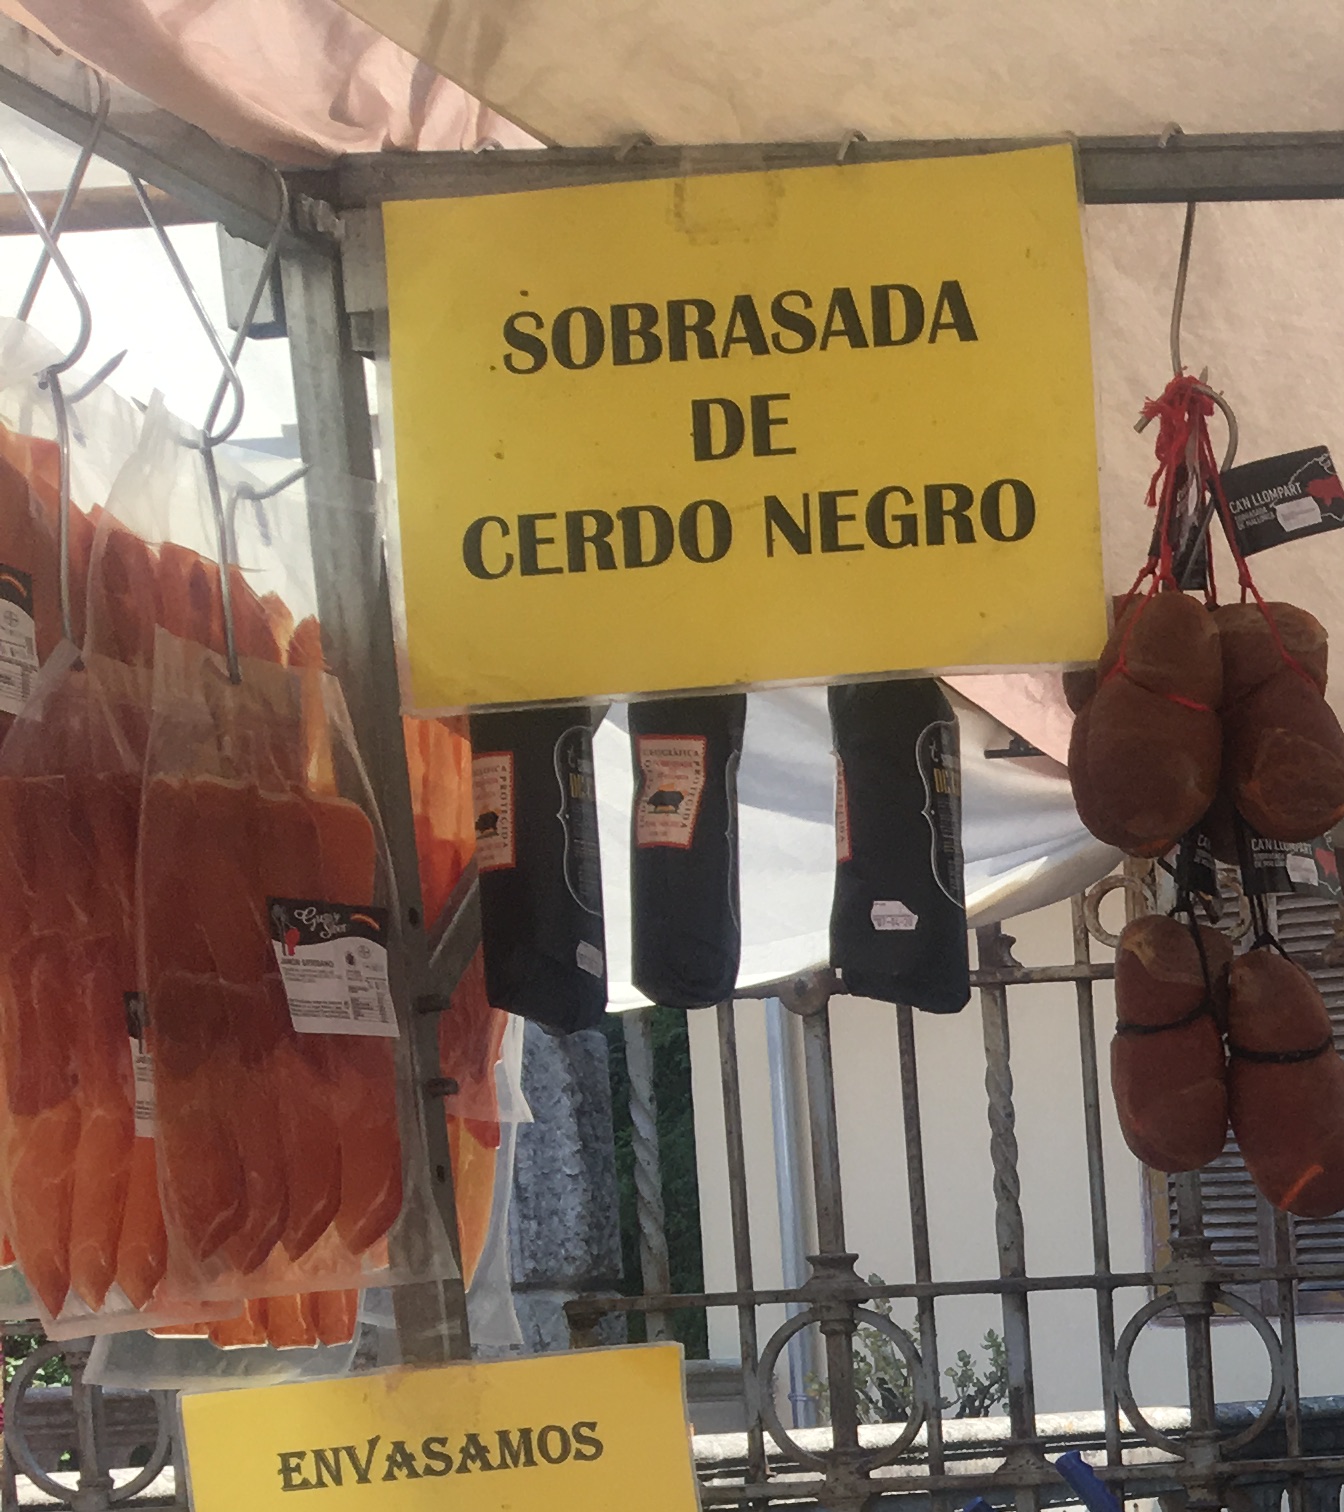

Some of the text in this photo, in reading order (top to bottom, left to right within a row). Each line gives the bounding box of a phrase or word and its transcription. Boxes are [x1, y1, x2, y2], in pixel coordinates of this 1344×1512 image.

[502, 280, 979, 375] SOBRASADA
[691, 394, 797, 461] DE
[462, 478, 1036, 580] CERDO NEGRO
[1251, 482, 1302, 506] LLOMPART
[277, 1421, 604, 1491] ENVASAMOS
